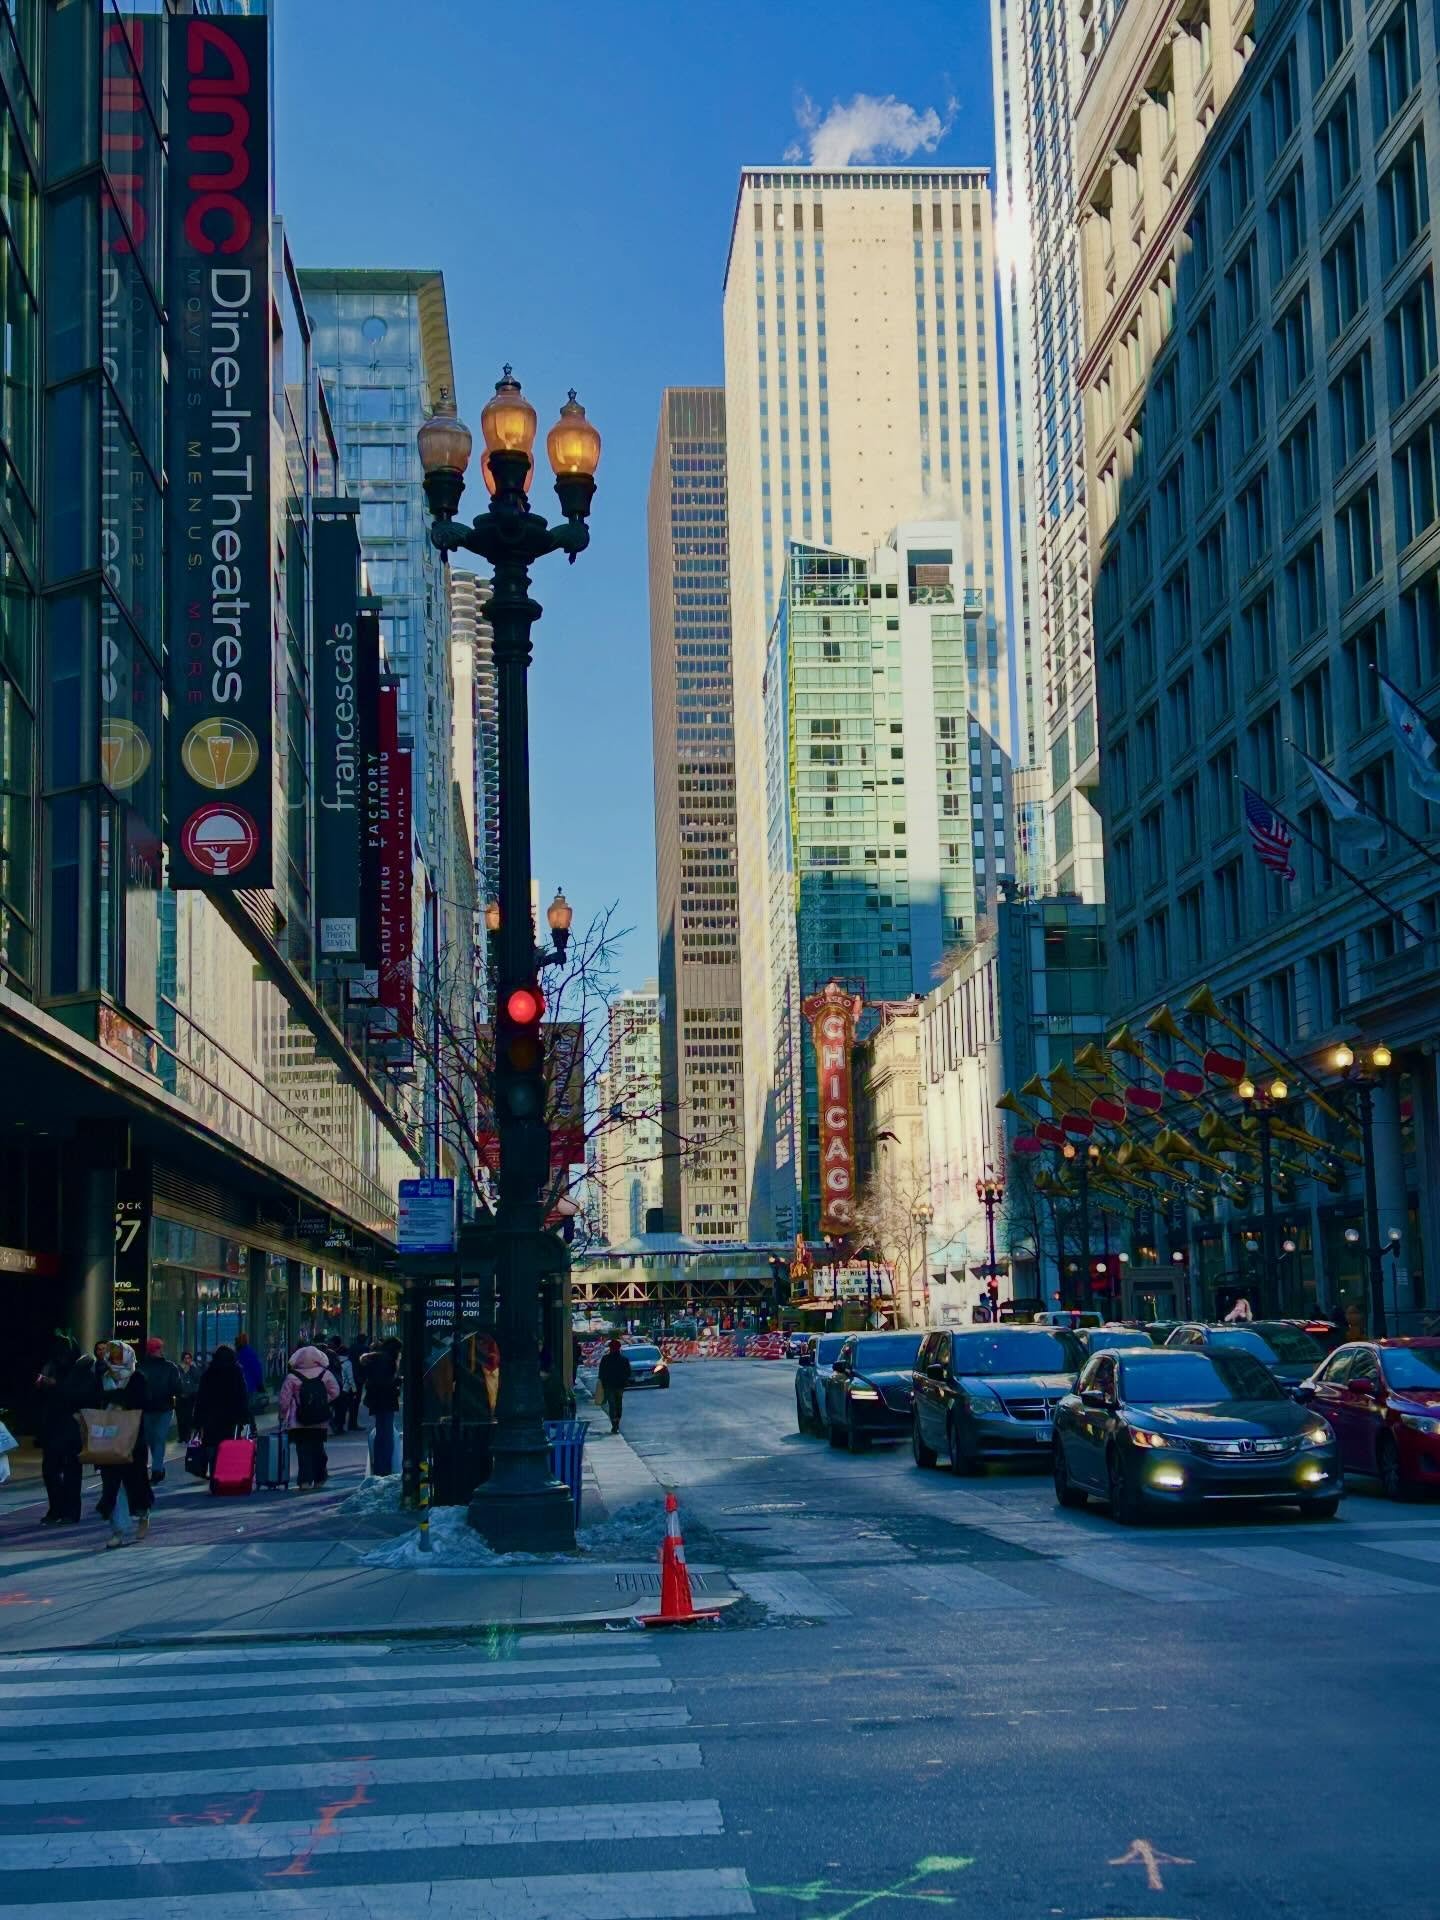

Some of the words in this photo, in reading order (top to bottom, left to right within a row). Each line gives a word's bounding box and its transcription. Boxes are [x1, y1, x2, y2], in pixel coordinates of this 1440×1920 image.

[184, 20, 252, 255] amc
[320, 621, 355, 812] francesca's
[367, 752, 379, 848] FACTORY
[325, 923, 352, 932] BLOCK
[326, 931, 352, 939] THIRTY
[326, 939, 352, 947] SEVEN
[821, 1014, 850, 1219] CHICAGO
[425, 1318, 454, 1328] paths.
